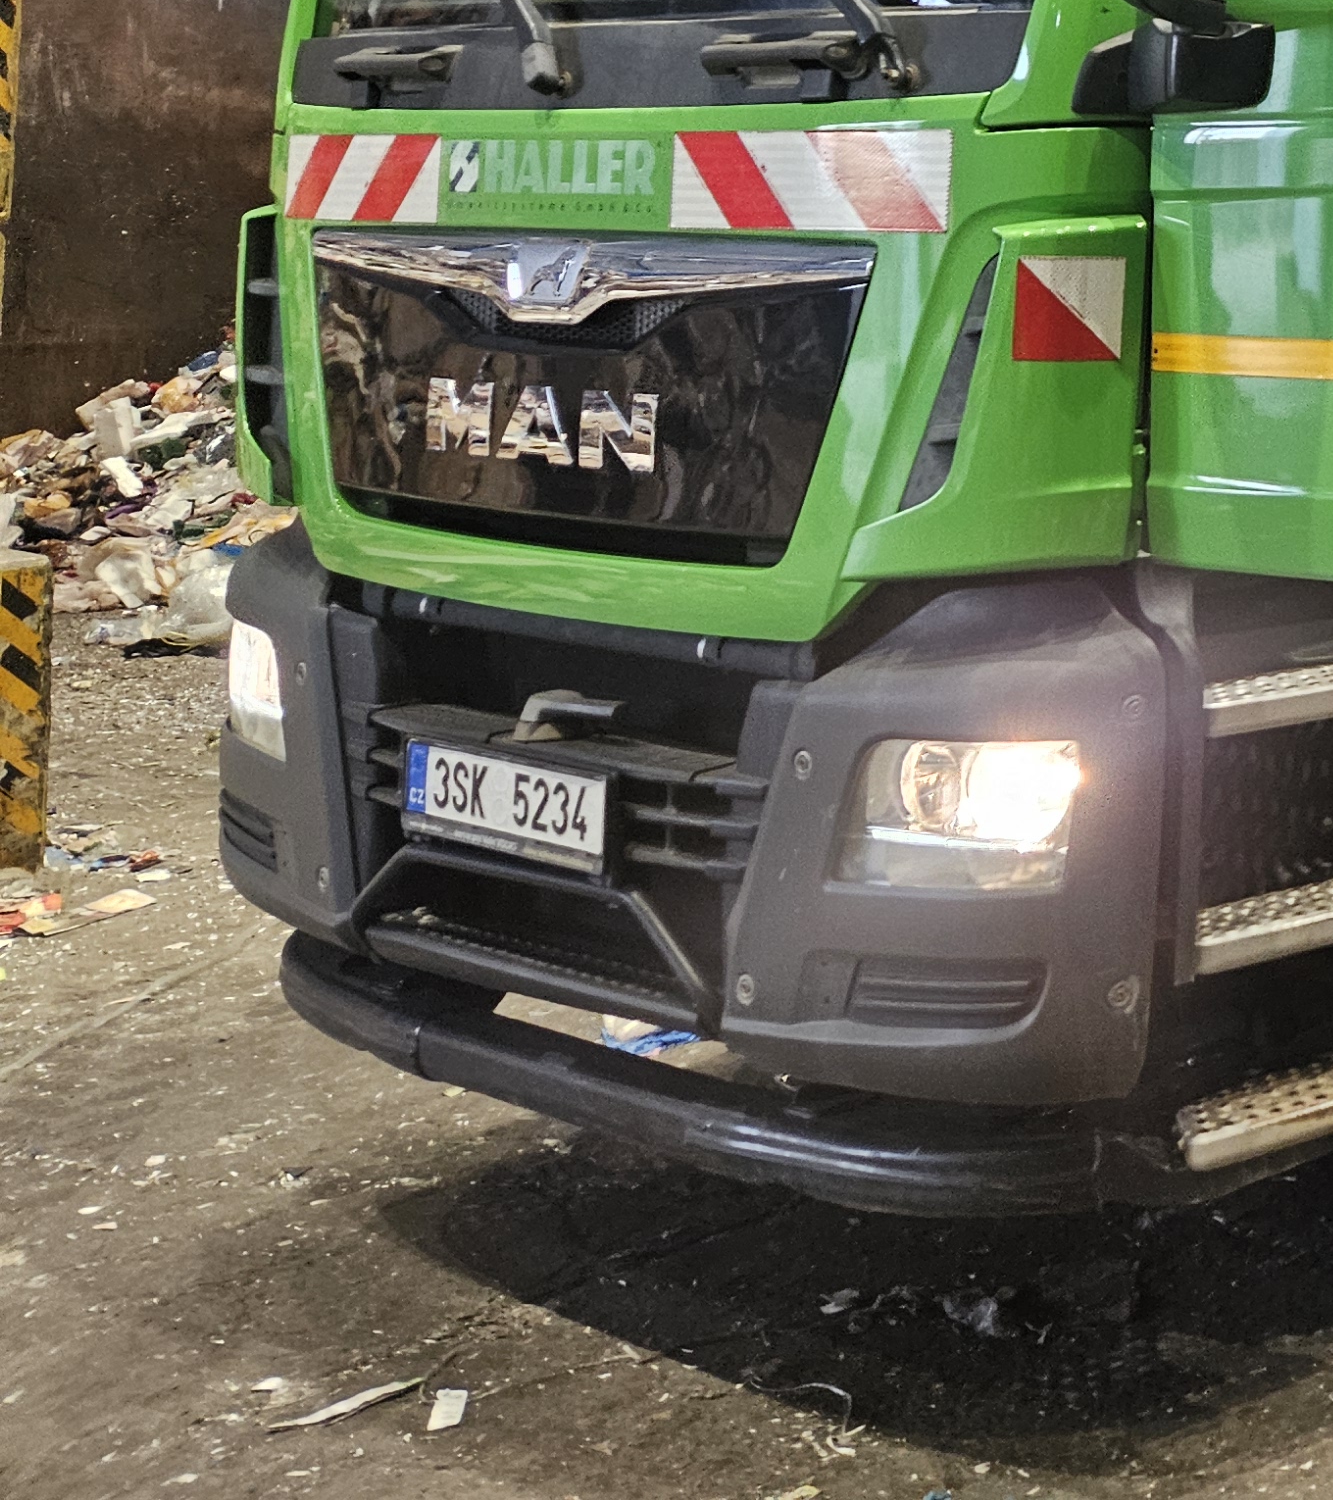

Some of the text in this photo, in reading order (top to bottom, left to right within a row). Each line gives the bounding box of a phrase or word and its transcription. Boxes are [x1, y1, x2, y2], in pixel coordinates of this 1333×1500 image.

[484, 139, 656, 196] HALLER
[425, 377, 660, 472] MAN
[409, 757, 588, 842] CZ 3SK 5234
